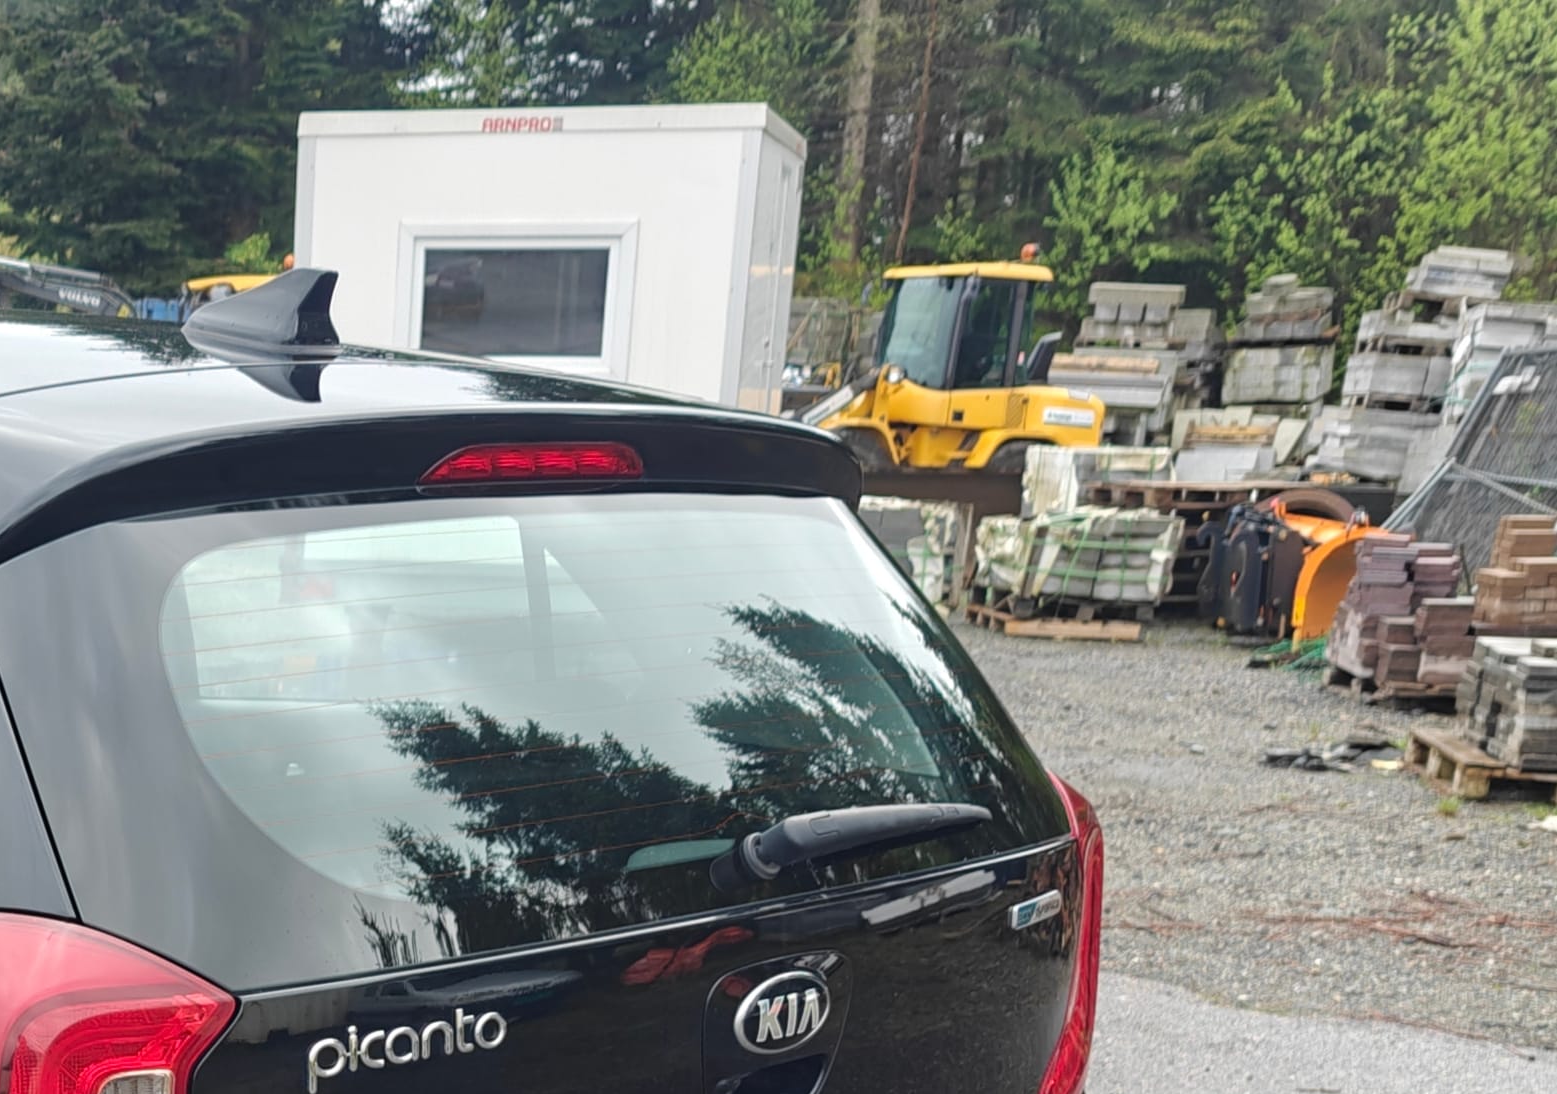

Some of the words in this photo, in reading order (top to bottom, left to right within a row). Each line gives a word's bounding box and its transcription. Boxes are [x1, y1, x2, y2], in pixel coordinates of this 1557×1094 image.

[58, 287, 101, 307] VOLVO
[755, 987, 820, 1043] KIA
[308, 1007, 507, 1094] picanto
